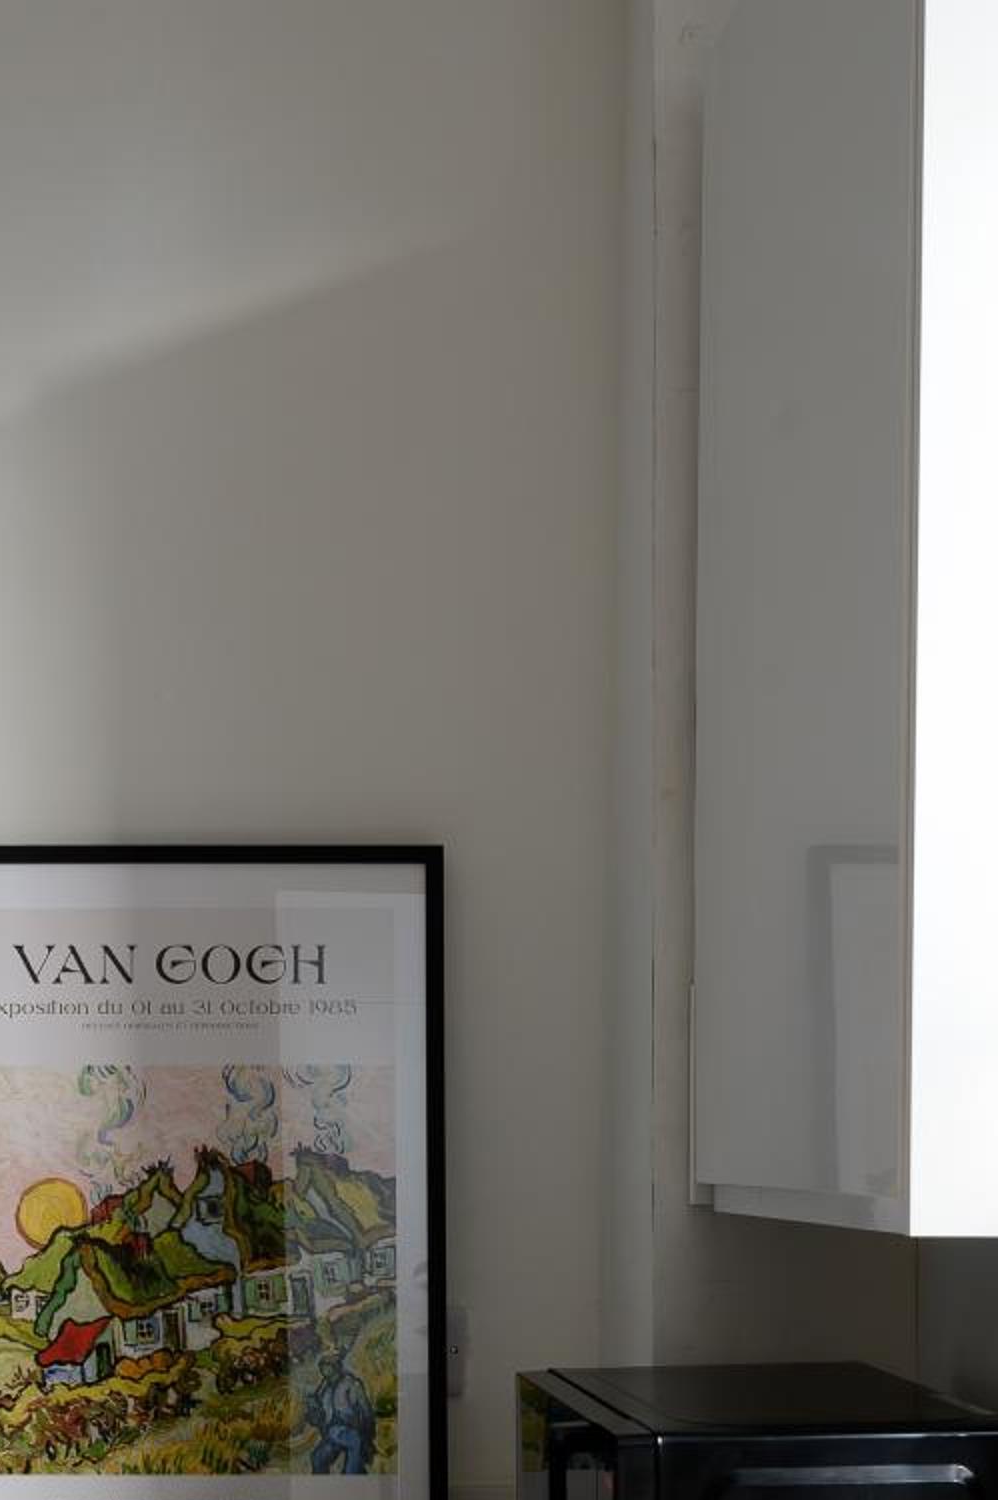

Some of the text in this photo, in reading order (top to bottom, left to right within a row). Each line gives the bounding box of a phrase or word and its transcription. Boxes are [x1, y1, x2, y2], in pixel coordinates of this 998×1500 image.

[12, 943, 328, 985] VAN GOGH
[97, 998, 123, 1016] du
[160, 1002, 185, 1016] au
[191, 999, 213, 1016] 31
[218, 998, 301, 1016] Octobre
